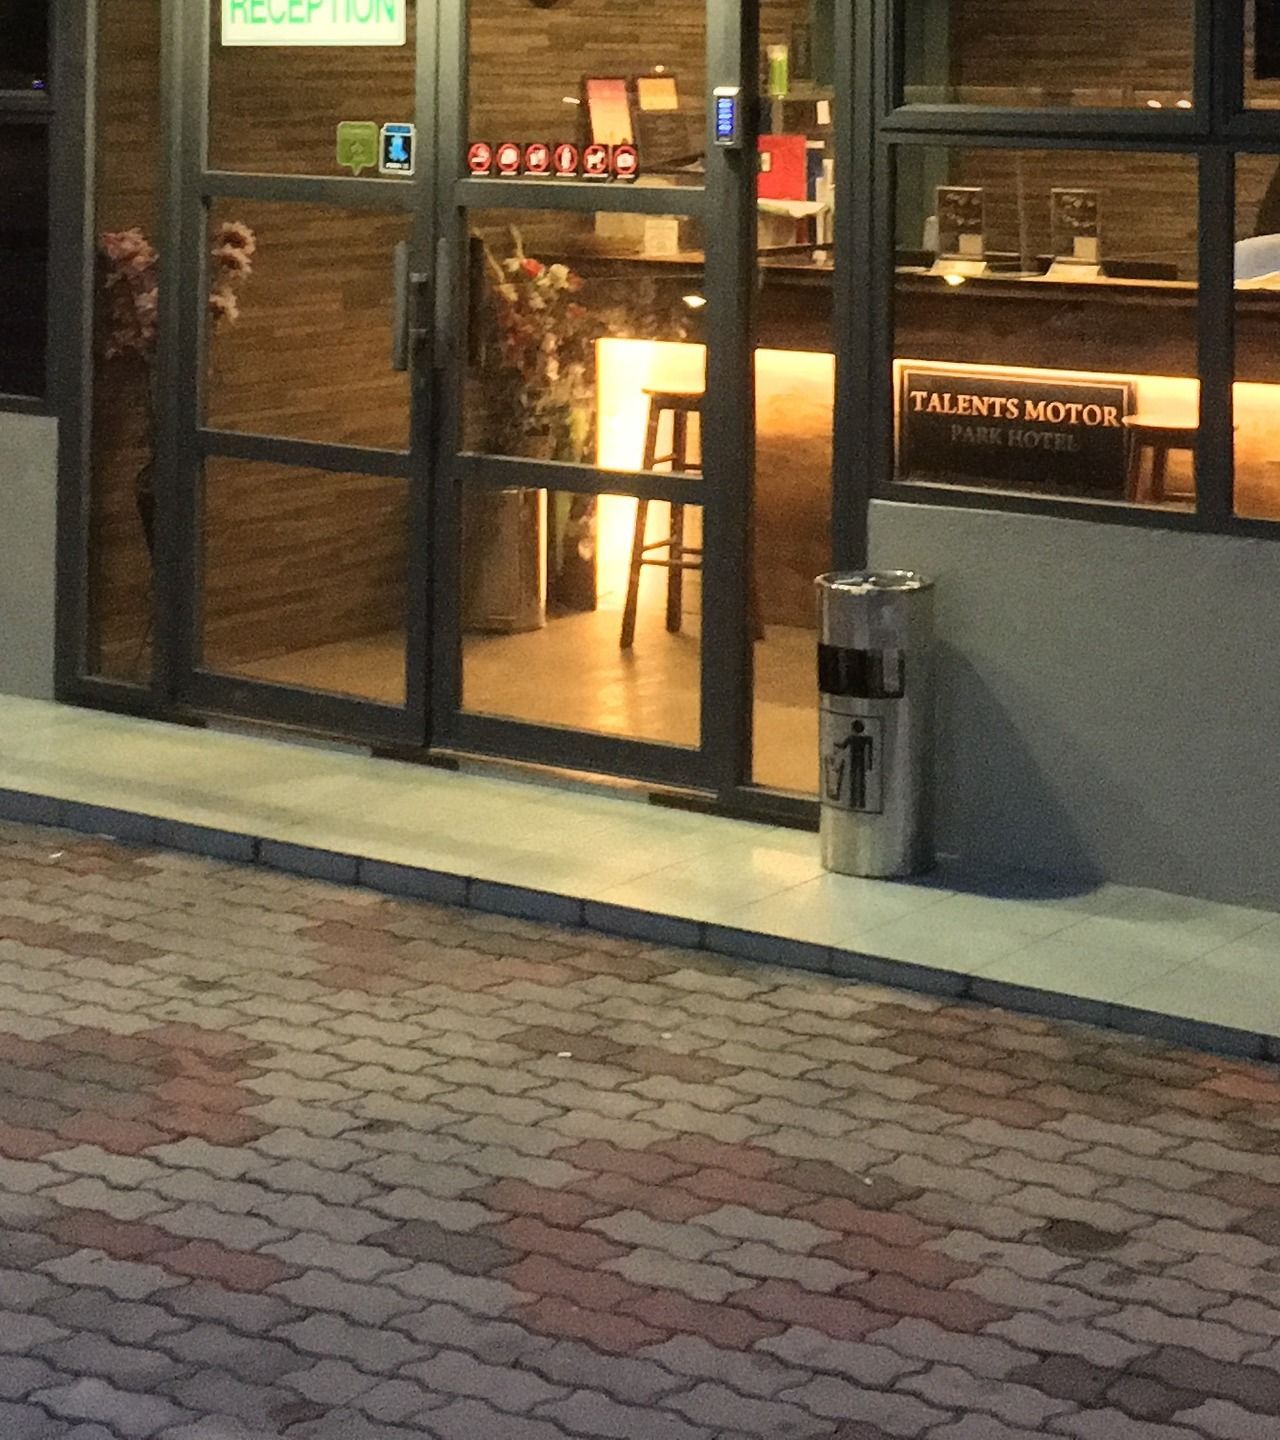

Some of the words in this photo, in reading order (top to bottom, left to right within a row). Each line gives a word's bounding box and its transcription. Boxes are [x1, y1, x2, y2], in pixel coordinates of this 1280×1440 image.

[910, 391, 1019, 419] TALENTS
[1024, 400, 1120, 427] MOTOR
[950, 424, 1003, 445] PARK
[1007, 430, 1081, 452] HOTEL
